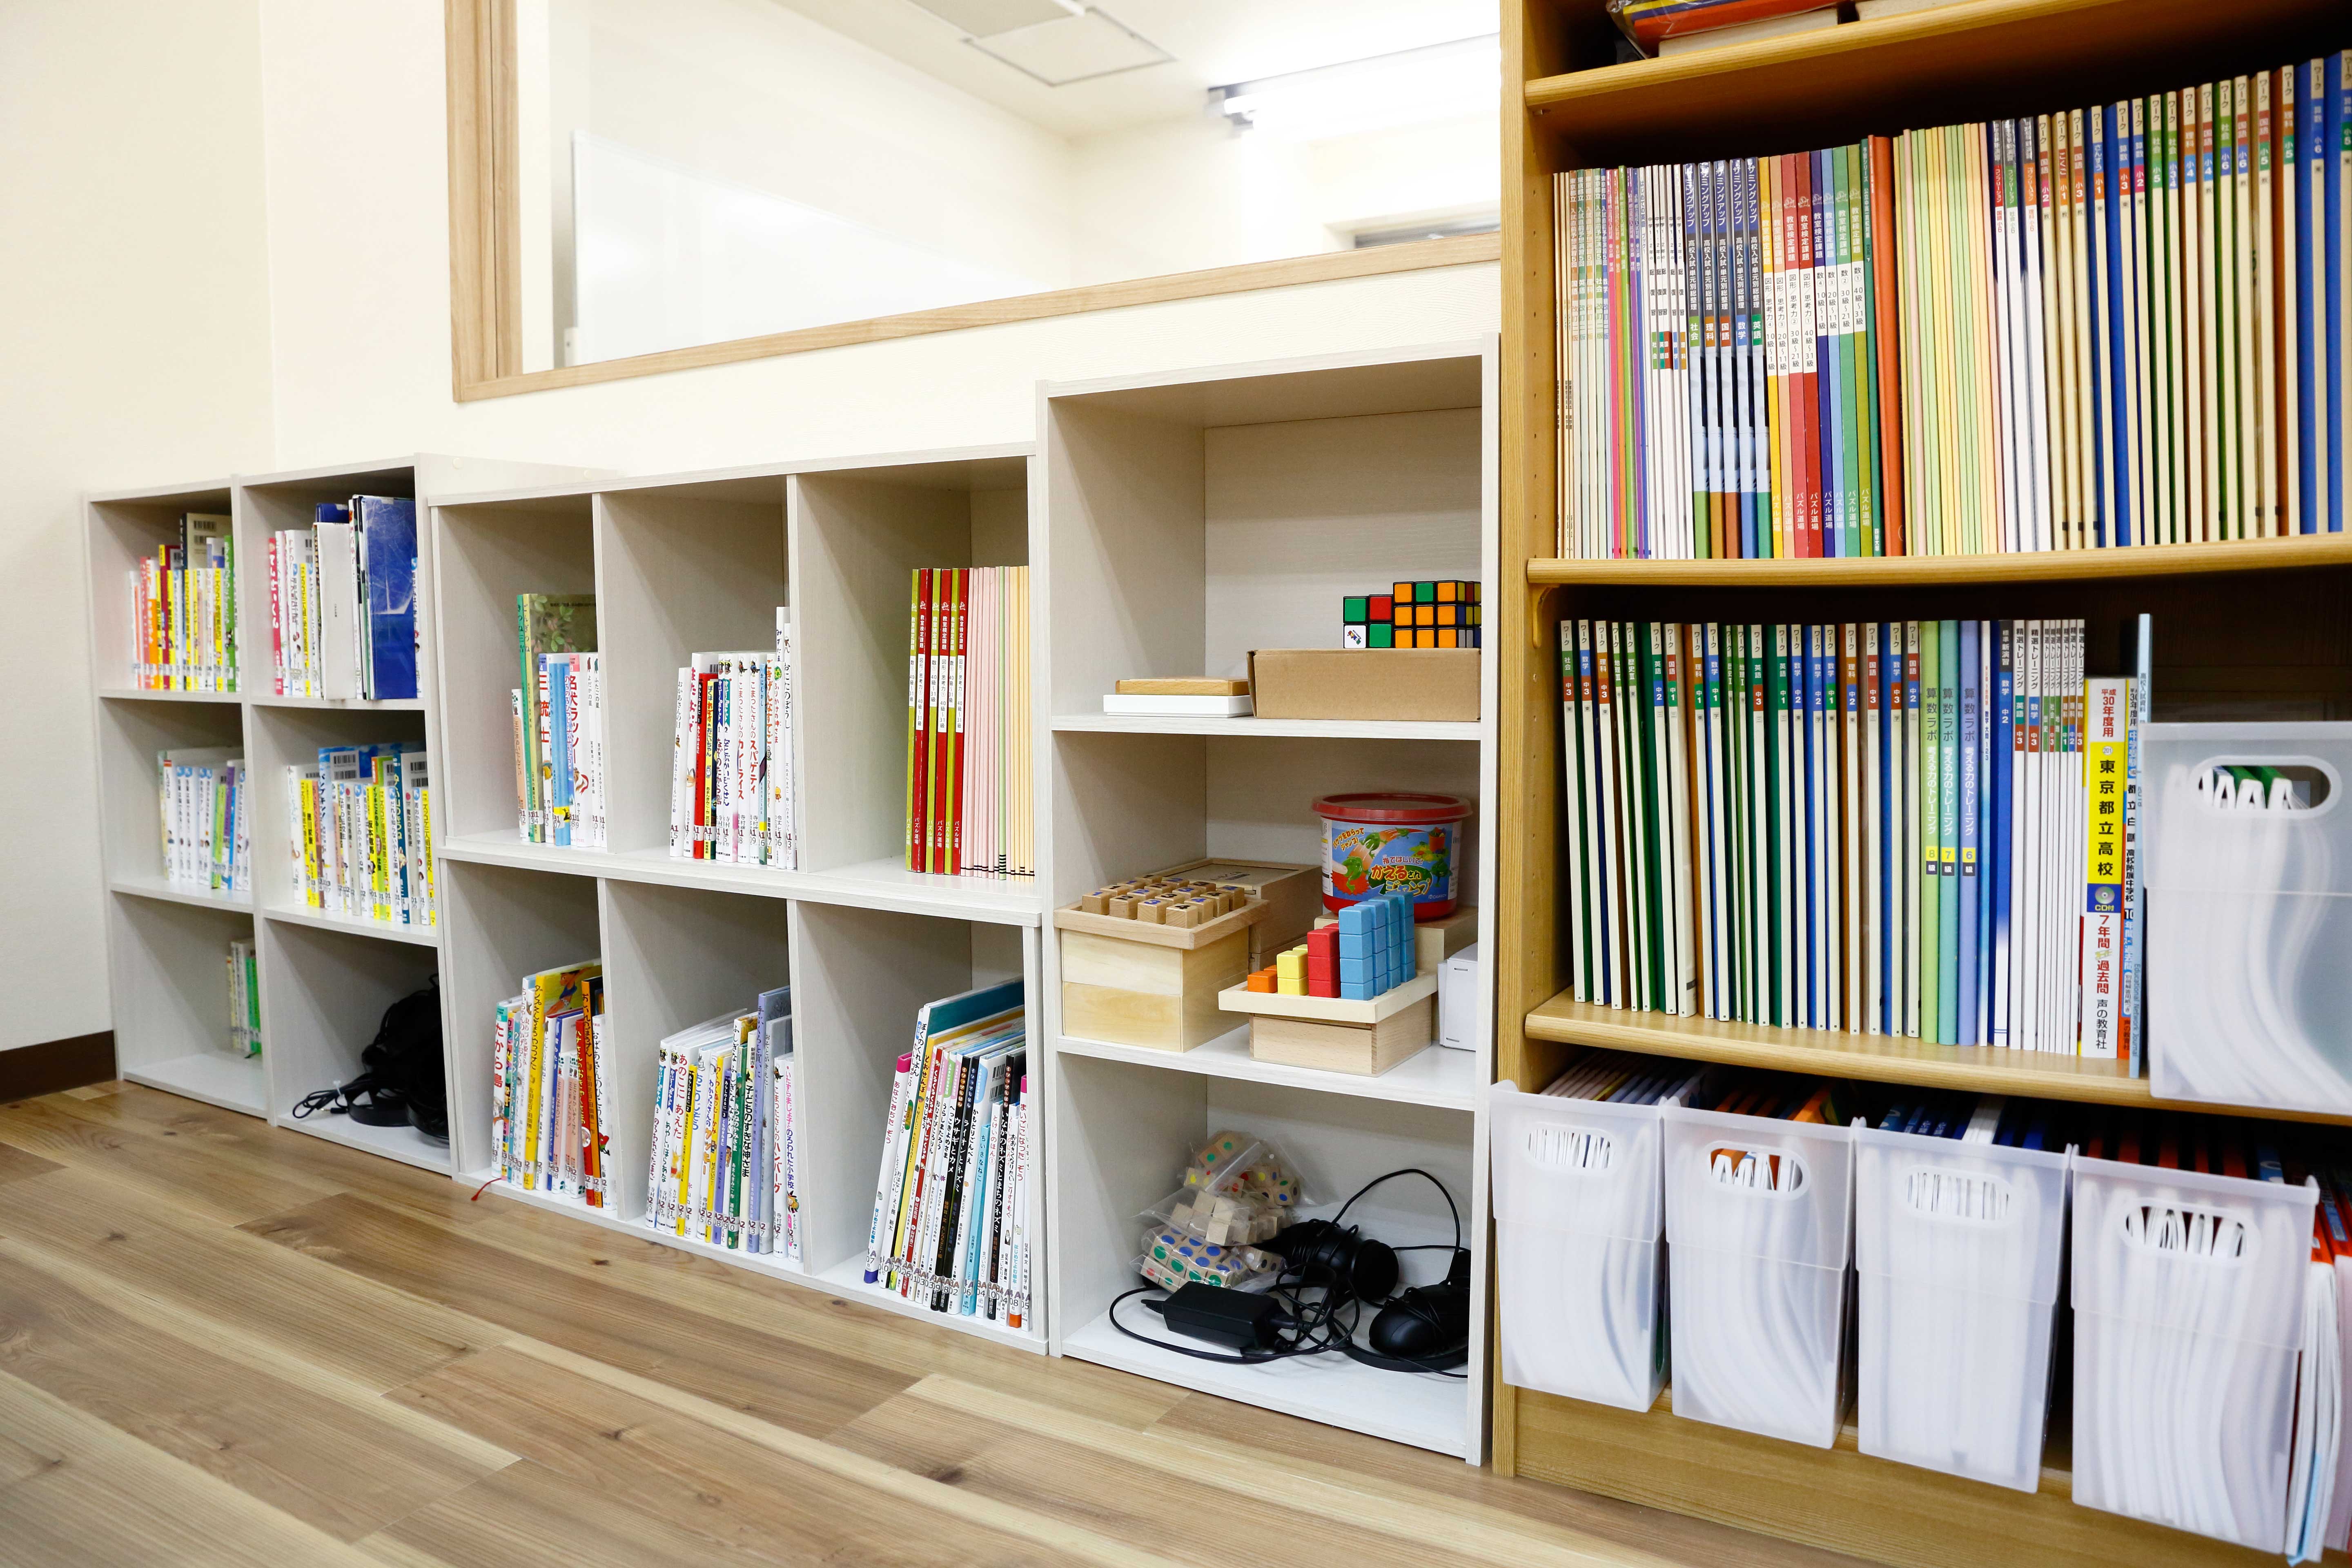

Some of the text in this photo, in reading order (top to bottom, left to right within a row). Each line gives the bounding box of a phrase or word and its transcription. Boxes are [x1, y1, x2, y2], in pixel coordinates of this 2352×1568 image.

[1733, 165, 1743, 225] サミングアップ
[2042, 186, 2049, 202] 小2
[2060, 185, 2067, 200] 小1
[2076, 182, 2083, 197] 小3
[2096, 178, 2103, 194] 小1
[2120, 174, 2128, 189] 小3
[2136, 171, 2144, 187] 小2
[1701, 167, 1710, 227] サミングアップ
[1706, 323, 1714, 341] 理科
[1716, 168, 1726, 226] サミングアップ
[1721, 323, 1730, 341] 国語
[1748, 165, 1762, 339] サミングアップ 英語
[1786, 216, 1795, 261] 教室検定課題
[1800, 215, 1809, 261] 教室検定課題
[1814, 213, 1823, 258] 教室検定課題
[1838, 210, 1847, 256] 教室検定課題
[1596, 278, 1602, 292] 社会
[1690, 323, 1699, 341] 社会
[1737, 322, 1746, 339] 数学
[1565, 657, 1571, 670] 社会
[1582, 656, 1589, 669] 数学
[1566, 683, 1572, 695] 中3
[1584, 682, 1589, 695] 中3
[1601, 685, 1607, 698] 中3
[1656, 687, 1662, 700] 中2
[1670, 688, 1676, 701] 中1
[1696, 690, 1702, 703] 中1
[1712, 688, 1718, 701] 中1
[1755, 691, 1762, 705] 中3
[1780, 690, 1786, 704] 中1
[1795, 690, 1801, 703] 中2
[1815, 691, 1821, 704] 中2
[1849, 691, 1855, 705] 中2
[2002, 680, 2009, 723] 数学 中2
[2017, 731, 2023, 744] 中3
[2031, 733, 2037, 745] 中3
[750, 739, 758, 794] スパゲティ
[1927, 688, 1937, 835] 算数ラボ 考える力のトレーニング
[1943, 688, 1953, 835] 算数ラボ 考える力のトレーニング
[1964, 688, 1975, 835] 算数ラボ 考える力のトレーニング
[2098, 760, 2115, 875] 東京都立高校
[1371, 864, 1421, 880] かえるさん
[1385, 878, 1431, 897] ジャンプ
[2096, 961, 2110, 1049] 過去問 声の教育社
[913, 1023, 927, 1076] ぼくのくれよん
[674, 1054, 687, 1139] あのこに あえた
[742, 1085, 754, 1177] 子どものすきな神さま
[938, 1103, 946, 1149] うらしまたろう
[944, 1105, 955, 1158] へっこきよめさま
[948, 1118, 960, 1173] ウサギとカメ
[967, 1109, 978, 1164] かもとりごんべえ
[1018, 1104, 1027, 1160] まいごになった
[774, 1143, 782, 1193] ハンバーグ
[956, 1120, 969, 1192] ライオンとネズミ
[978, 1135, 986, 1181] ちいさなねこ
[994, 1111, 1008, 1233] いなかのネズミとまちのネズミ
[1008, 1134, 1016, 1181] おおきくなりたい
